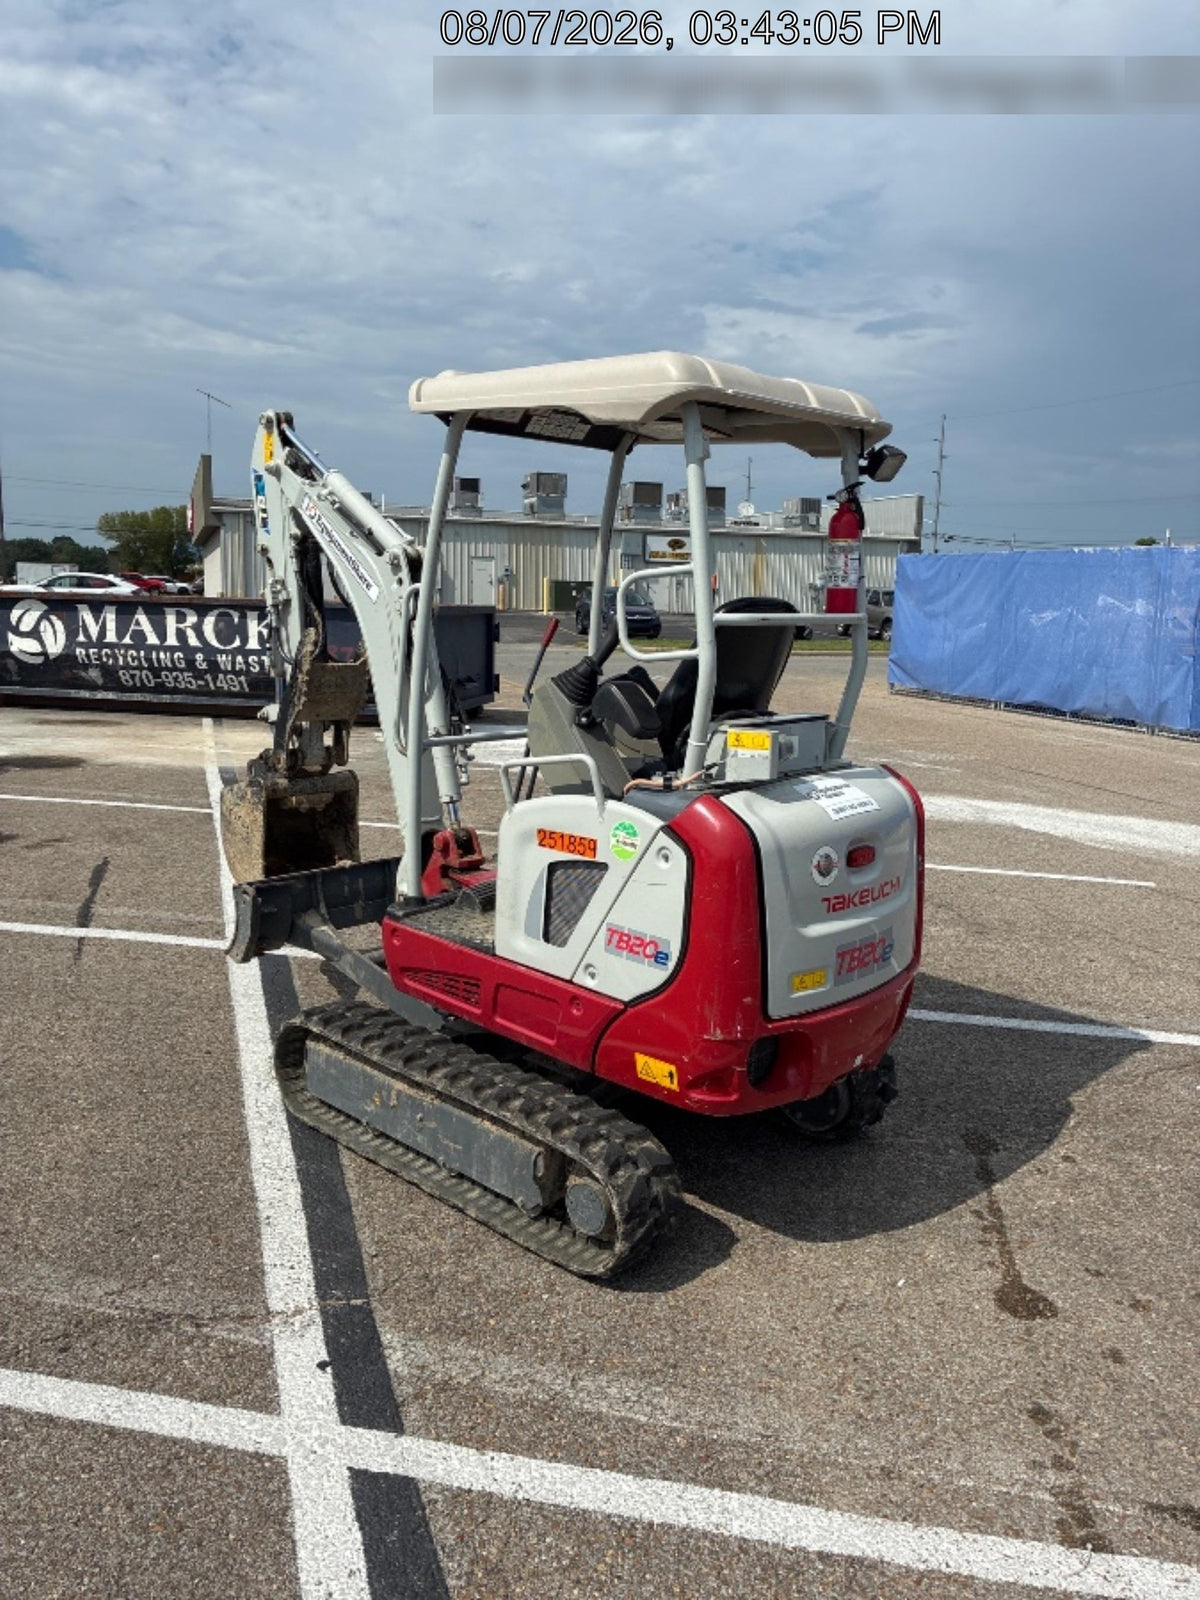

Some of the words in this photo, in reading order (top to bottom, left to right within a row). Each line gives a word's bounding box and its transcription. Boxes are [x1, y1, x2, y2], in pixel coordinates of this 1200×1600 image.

[76, 647, 185, 668] RECYCLING
[195, 653, 209, 669] &
[119, 670, 249, 693] 870-935-1491
[537, 829, 597, 858] 251859
